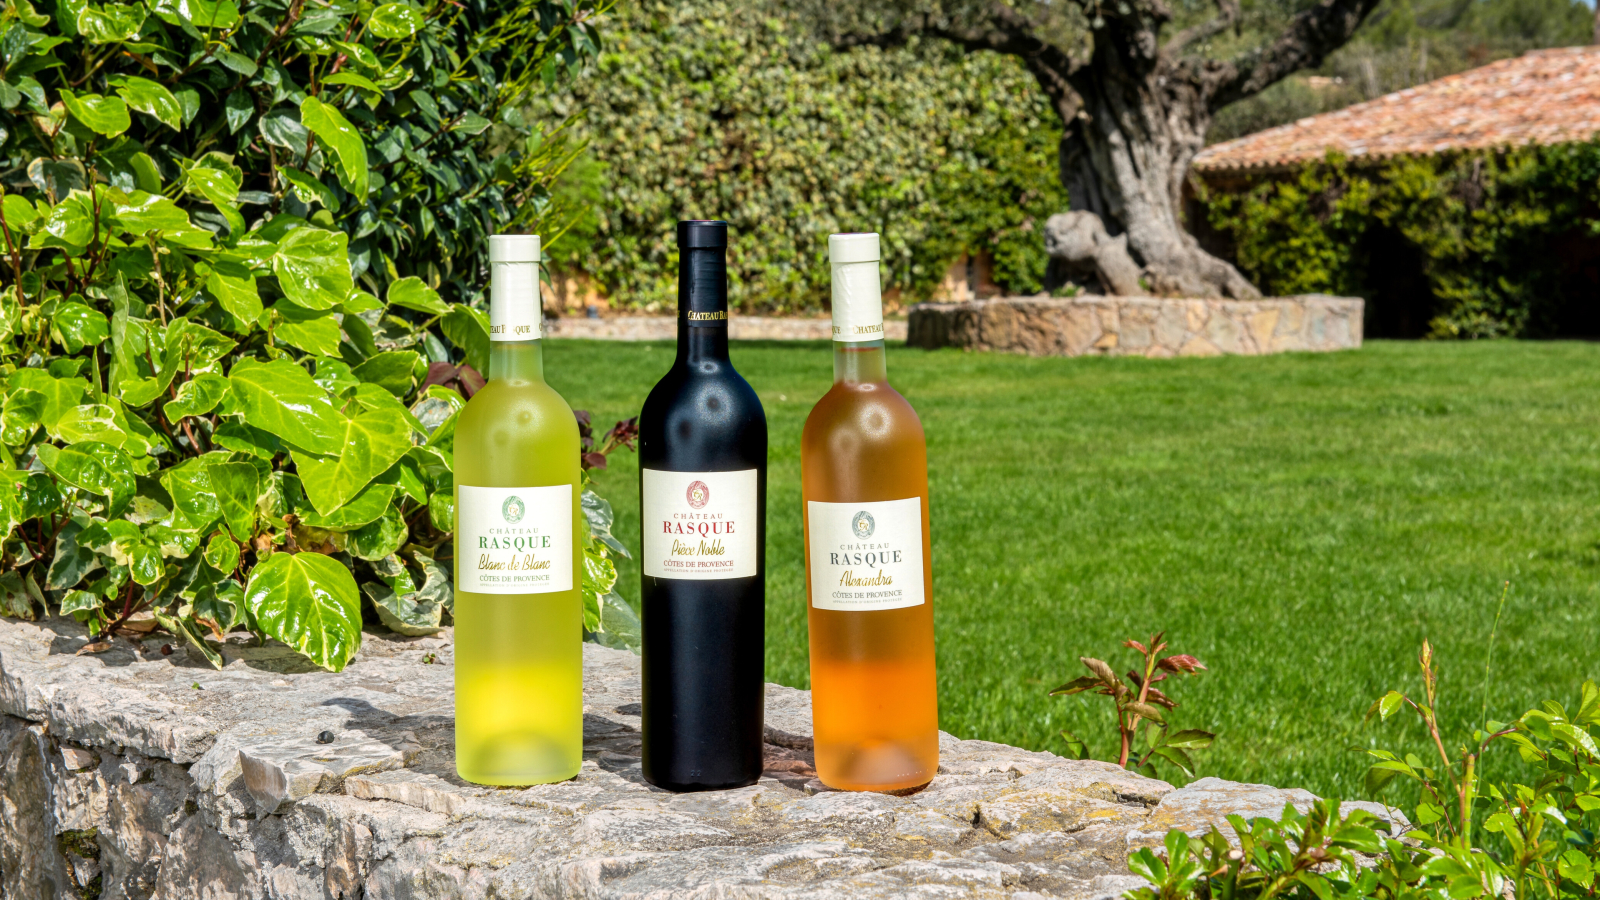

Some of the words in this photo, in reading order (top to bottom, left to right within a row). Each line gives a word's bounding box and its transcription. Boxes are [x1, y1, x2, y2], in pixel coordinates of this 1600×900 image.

[673, 512, 723, 520] CHÂTEAU
[489, 527, 539, 535] CHÂTEAU
[663, 521, 735, 538] RASQUE
[478, 536, 551, 552] RASQUE
[671, 539, 695, 556] Pièce
[696, 538, 725, 556] Noble
[840, 543, 890, 551] CHÂTEAU
[478, 553, 506, 571] Blanc
[507, 554, 520, 571] de
[521, 553, 551, 571] Blanc
[663, 559, 684, 568] CÔTES
[697, 560, 734, 568] PROVENCE
[830, 550, 902, 568] RASQUE
[479, 574, 500, 582] CÔTES
[501, 575, 512, 583] DE
[513, 574, 550, 583] PROVENCE
[840, 569, 893, 587] Alexandra
[832, 591, 853, 599] CÔTES
[866, 590, 903, 599] PROVENCE
